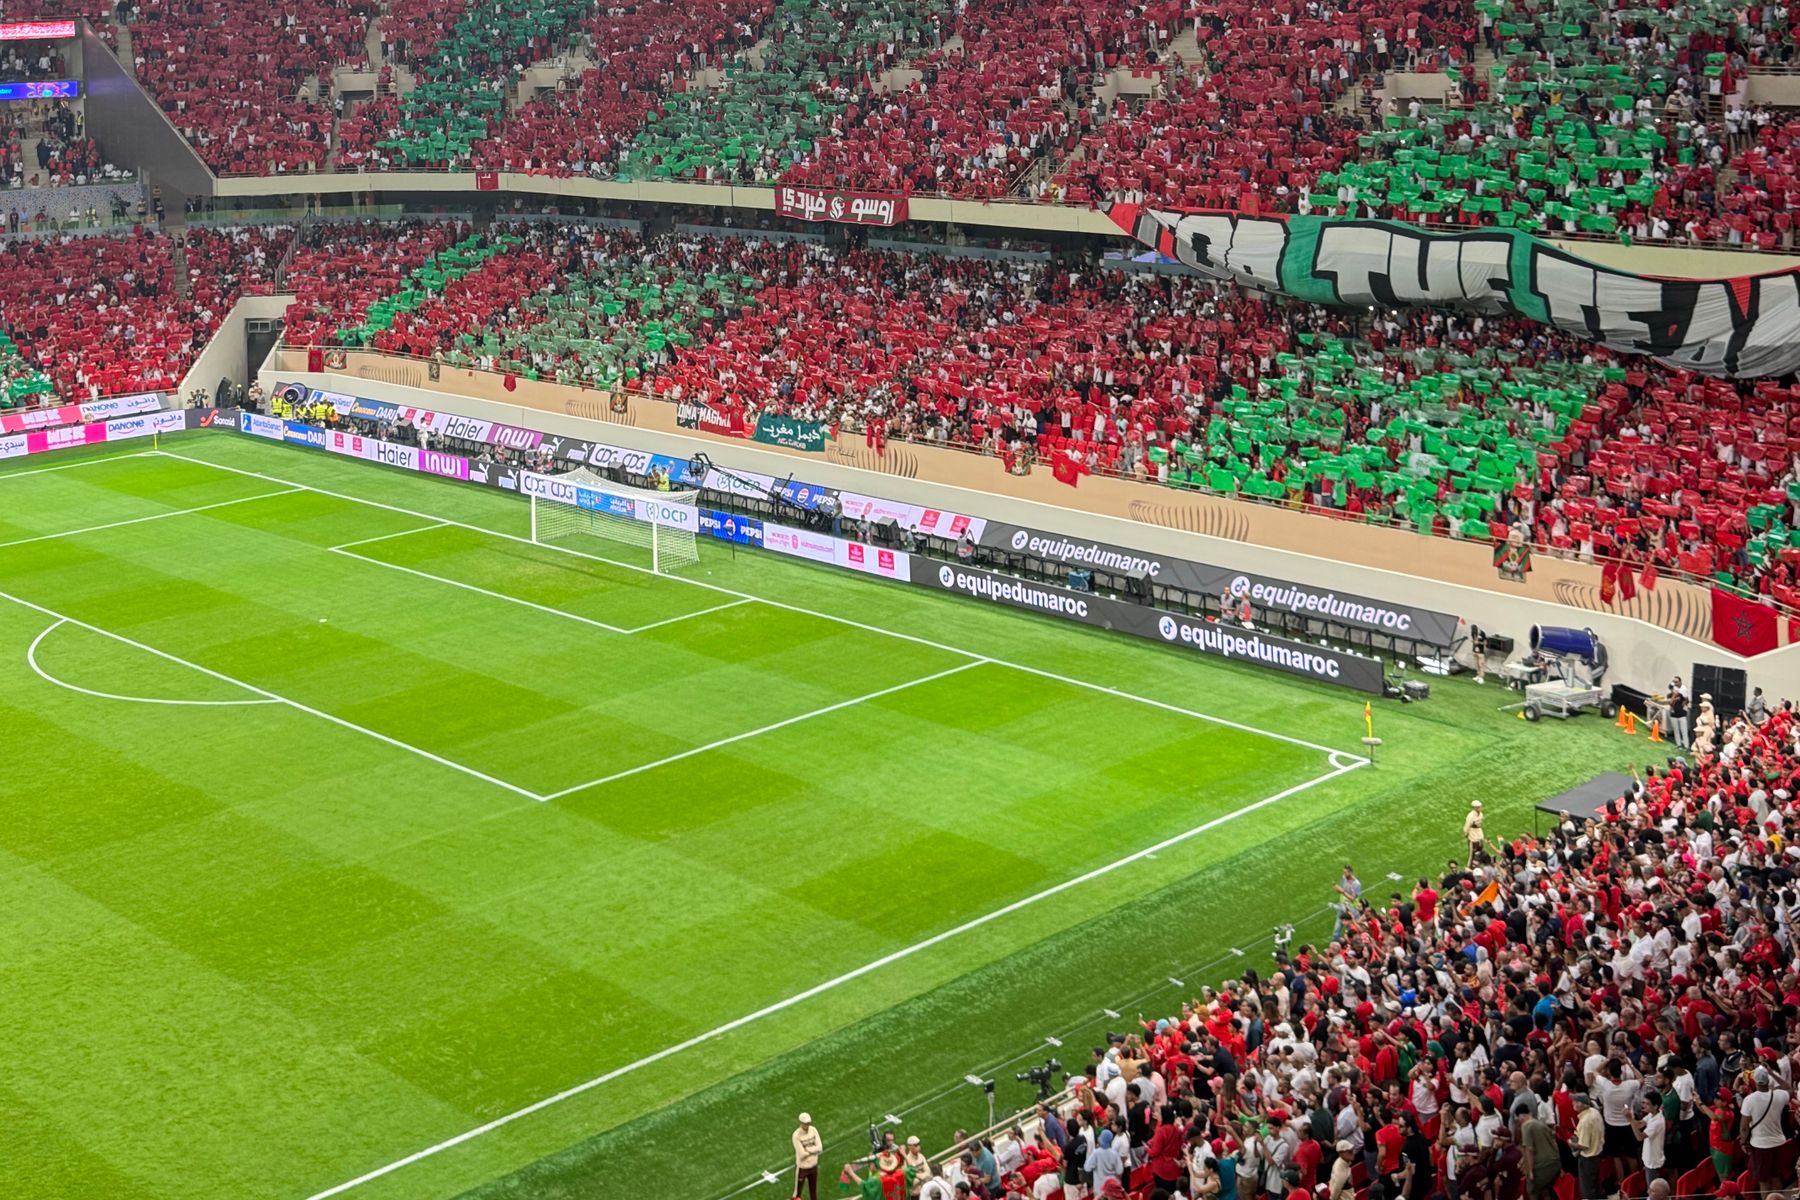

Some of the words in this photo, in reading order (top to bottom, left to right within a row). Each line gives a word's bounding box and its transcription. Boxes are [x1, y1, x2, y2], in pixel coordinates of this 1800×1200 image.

[307, 430, 325, 446] DARI
[444, 417, 485, 440] Haier
[377, 442, 412, 467] Haier
[622, 452, 646, 472] CDG
[551, 482, 573, 500] CDG
[812, 494, 836, 506] PEPSI
[661, 507, 688, 523] OCP
[699, 516, 721, 530] PEPSI
[740, 525, 763, 539] PEPSI
[1028, 535, 1161, 577] equipedumaroc
[956, 569, 1088, 618] equipedumaroc
[1250, 583, 1412, 631] equipedumaroc
[1180, 622, 1340, 678] equipedumaroc
